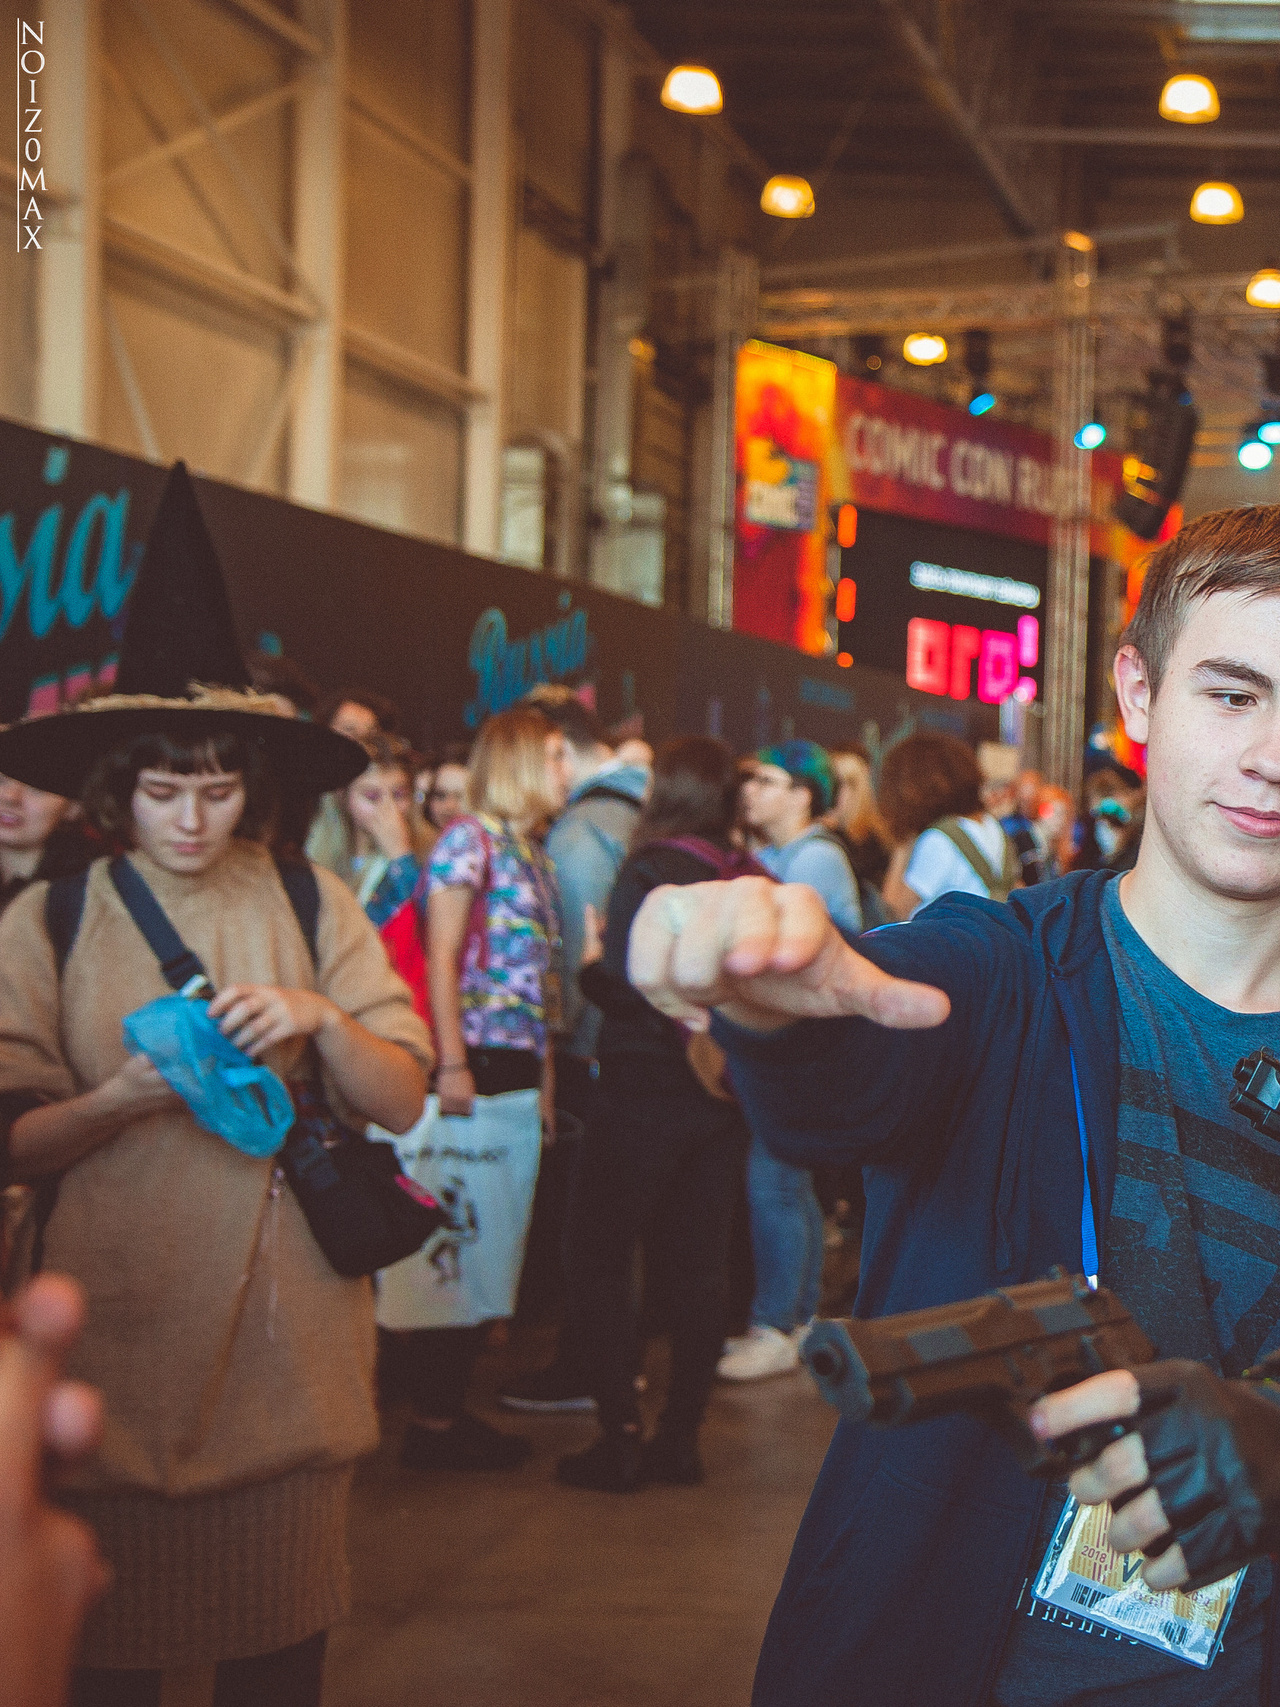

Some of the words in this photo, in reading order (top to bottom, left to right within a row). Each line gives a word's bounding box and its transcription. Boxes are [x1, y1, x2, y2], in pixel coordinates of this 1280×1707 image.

[847, 413, 948, 491] COMIC
[950, 440, 1014, 502] CON
[1081, 1545, 1107, 1563] 2018
